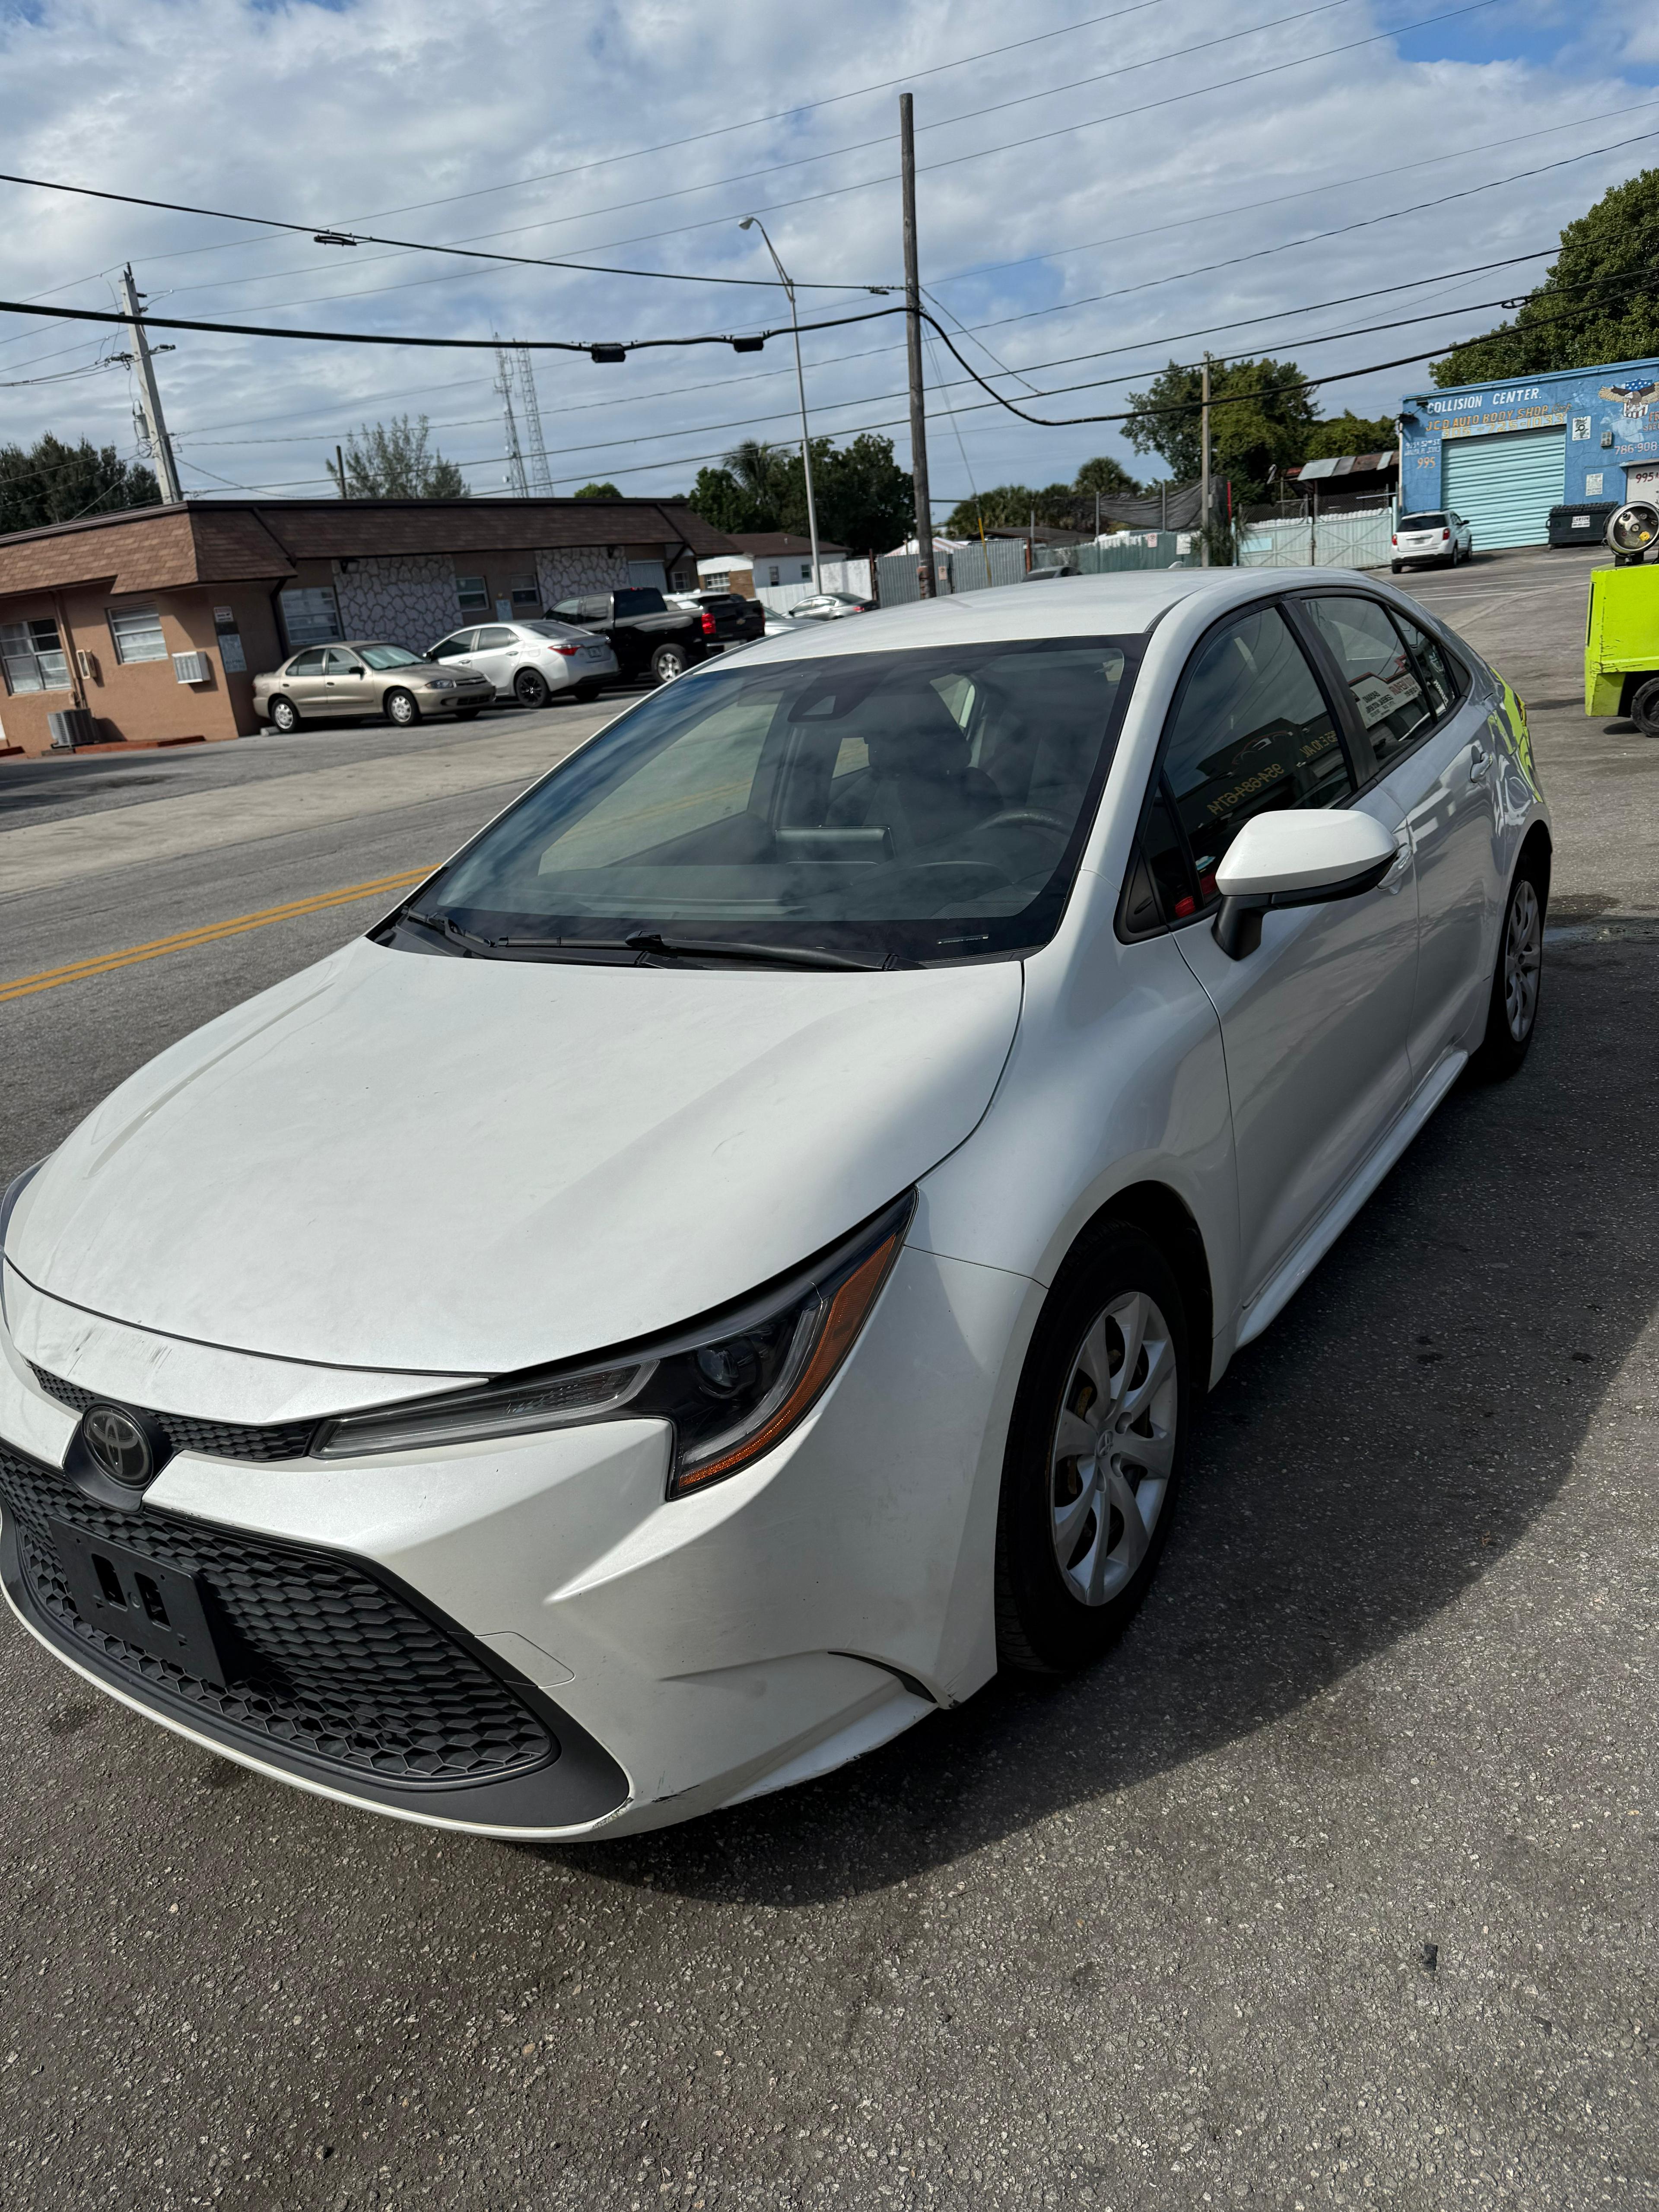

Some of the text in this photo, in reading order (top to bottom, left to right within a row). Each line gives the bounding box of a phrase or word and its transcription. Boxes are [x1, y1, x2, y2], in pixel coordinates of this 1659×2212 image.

[1427, 388, 1542, 414] COLLISION CENTER.
[1426, 419, 1450, 431] JCD
[1452, 415, 1479, 428] AUTO
[1482, 410, 1514, 423] BODY
[1517, 405, 1548, 419] SHOP
[1417, 456, 1436, 470] 995
[1636, 472, 1654, 483] 995
